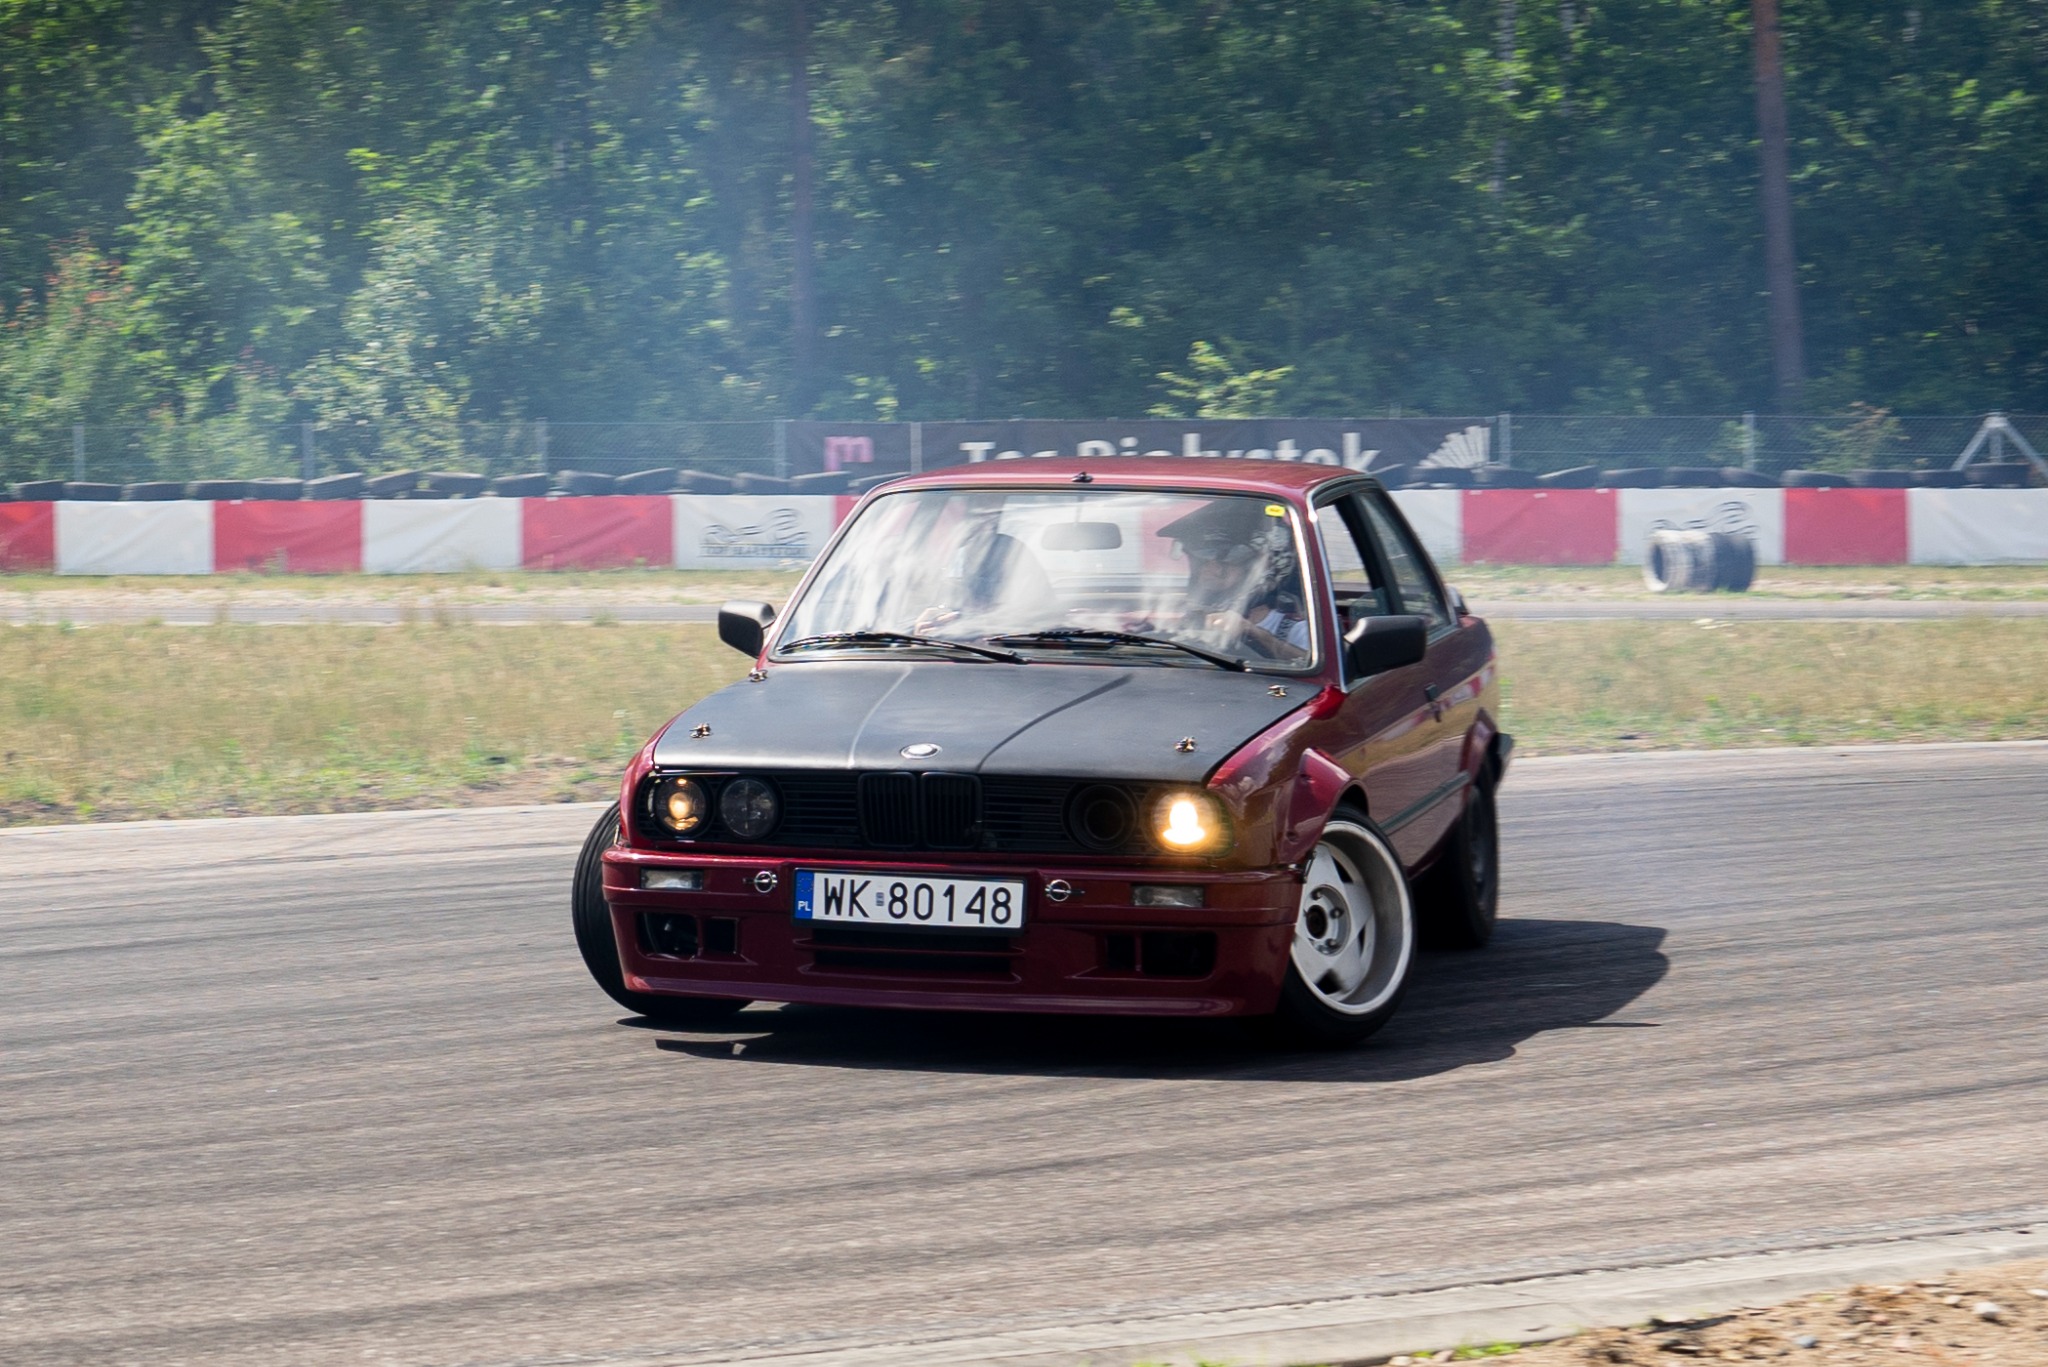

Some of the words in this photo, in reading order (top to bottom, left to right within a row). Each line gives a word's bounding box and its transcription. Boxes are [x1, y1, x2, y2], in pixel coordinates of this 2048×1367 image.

[797, 900, 811, 912] PL
[824, 878, 871, 917] WK
[888, 882, 1011, 924] 80148
